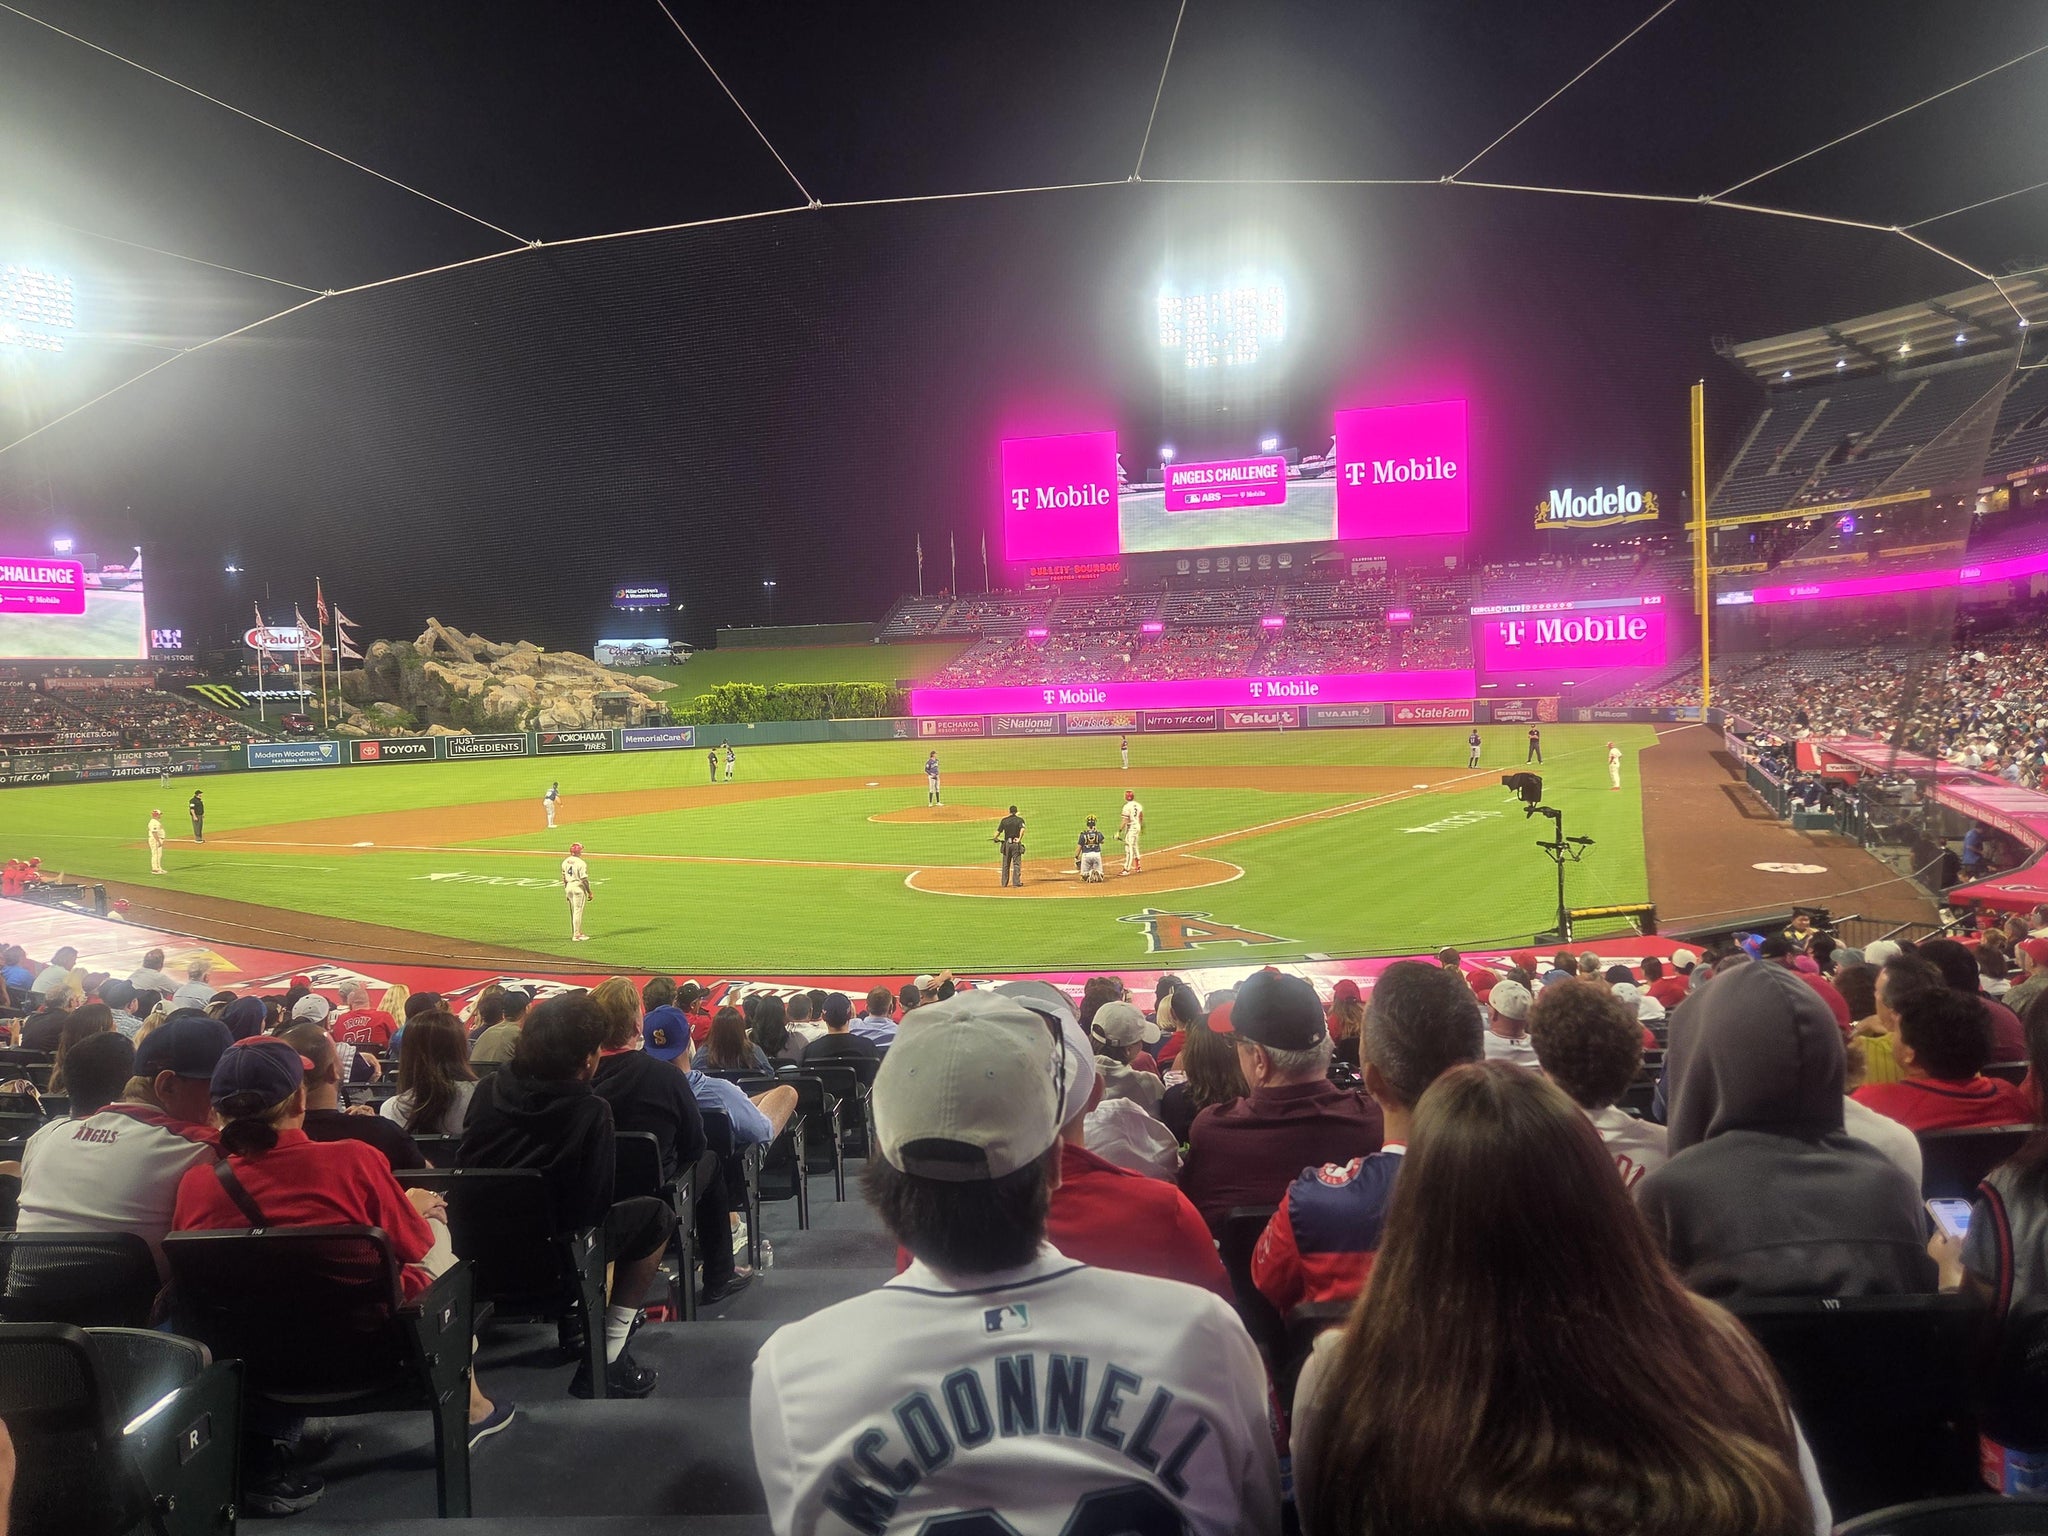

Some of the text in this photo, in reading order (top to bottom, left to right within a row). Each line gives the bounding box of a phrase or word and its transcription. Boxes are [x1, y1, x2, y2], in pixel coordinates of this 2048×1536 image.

[1172, 464, 1279, 486] ANGELS CHALLENGE
[1372, 456, 1457, 484] Mobile
[1035, 484, 1110, 510] Mobile
[1202, 492, 1222, 502] ABS
[1549, 485, 1642, 519] Modelo
[0, 565, 75, 585] CHALLENGE
[35, 595, 61, 605] Mobile
[1535, 614, 1648, 645] Mobile
[171, 654, 195, 662] STORE
[1267, 680, 1320, 697] Mobile
[1058, 688, 1107, 704] Mobile
[1010, 717, 1052, 729] National
[1069, 715, 1110, 729] Surfside
[1147, 714, 1214, 725] NITTO TIRE.COM
[1228, 710, 1295, 724] Yakult
[938, 720, 979, 729] PECHANGA
[454, 736, 476, 745] JUST
[557, 732, 607, 743] YOKOHAMA
[625, 734, 681, 743] MemorialCare
[254, 749, 320, 759] Modern Woodmen
[382, 743, 427, 755] TOYOTA
[454, 742, 519, 754] INGREDIENTS
[9, 772, 50, 782] TIRE.COM
[567, 866, 573, 878] 4
[343, 1015, 372, 1031] TROUT
[72, 1122, 119, 1144] ANGELS
[1822, 1298, 1840, 1310] 117
[444, 1309, 450, 1323] P
[190, 1429, 199, 1449] R
[821, 1353, 1211, 1536] MCDONNELL
